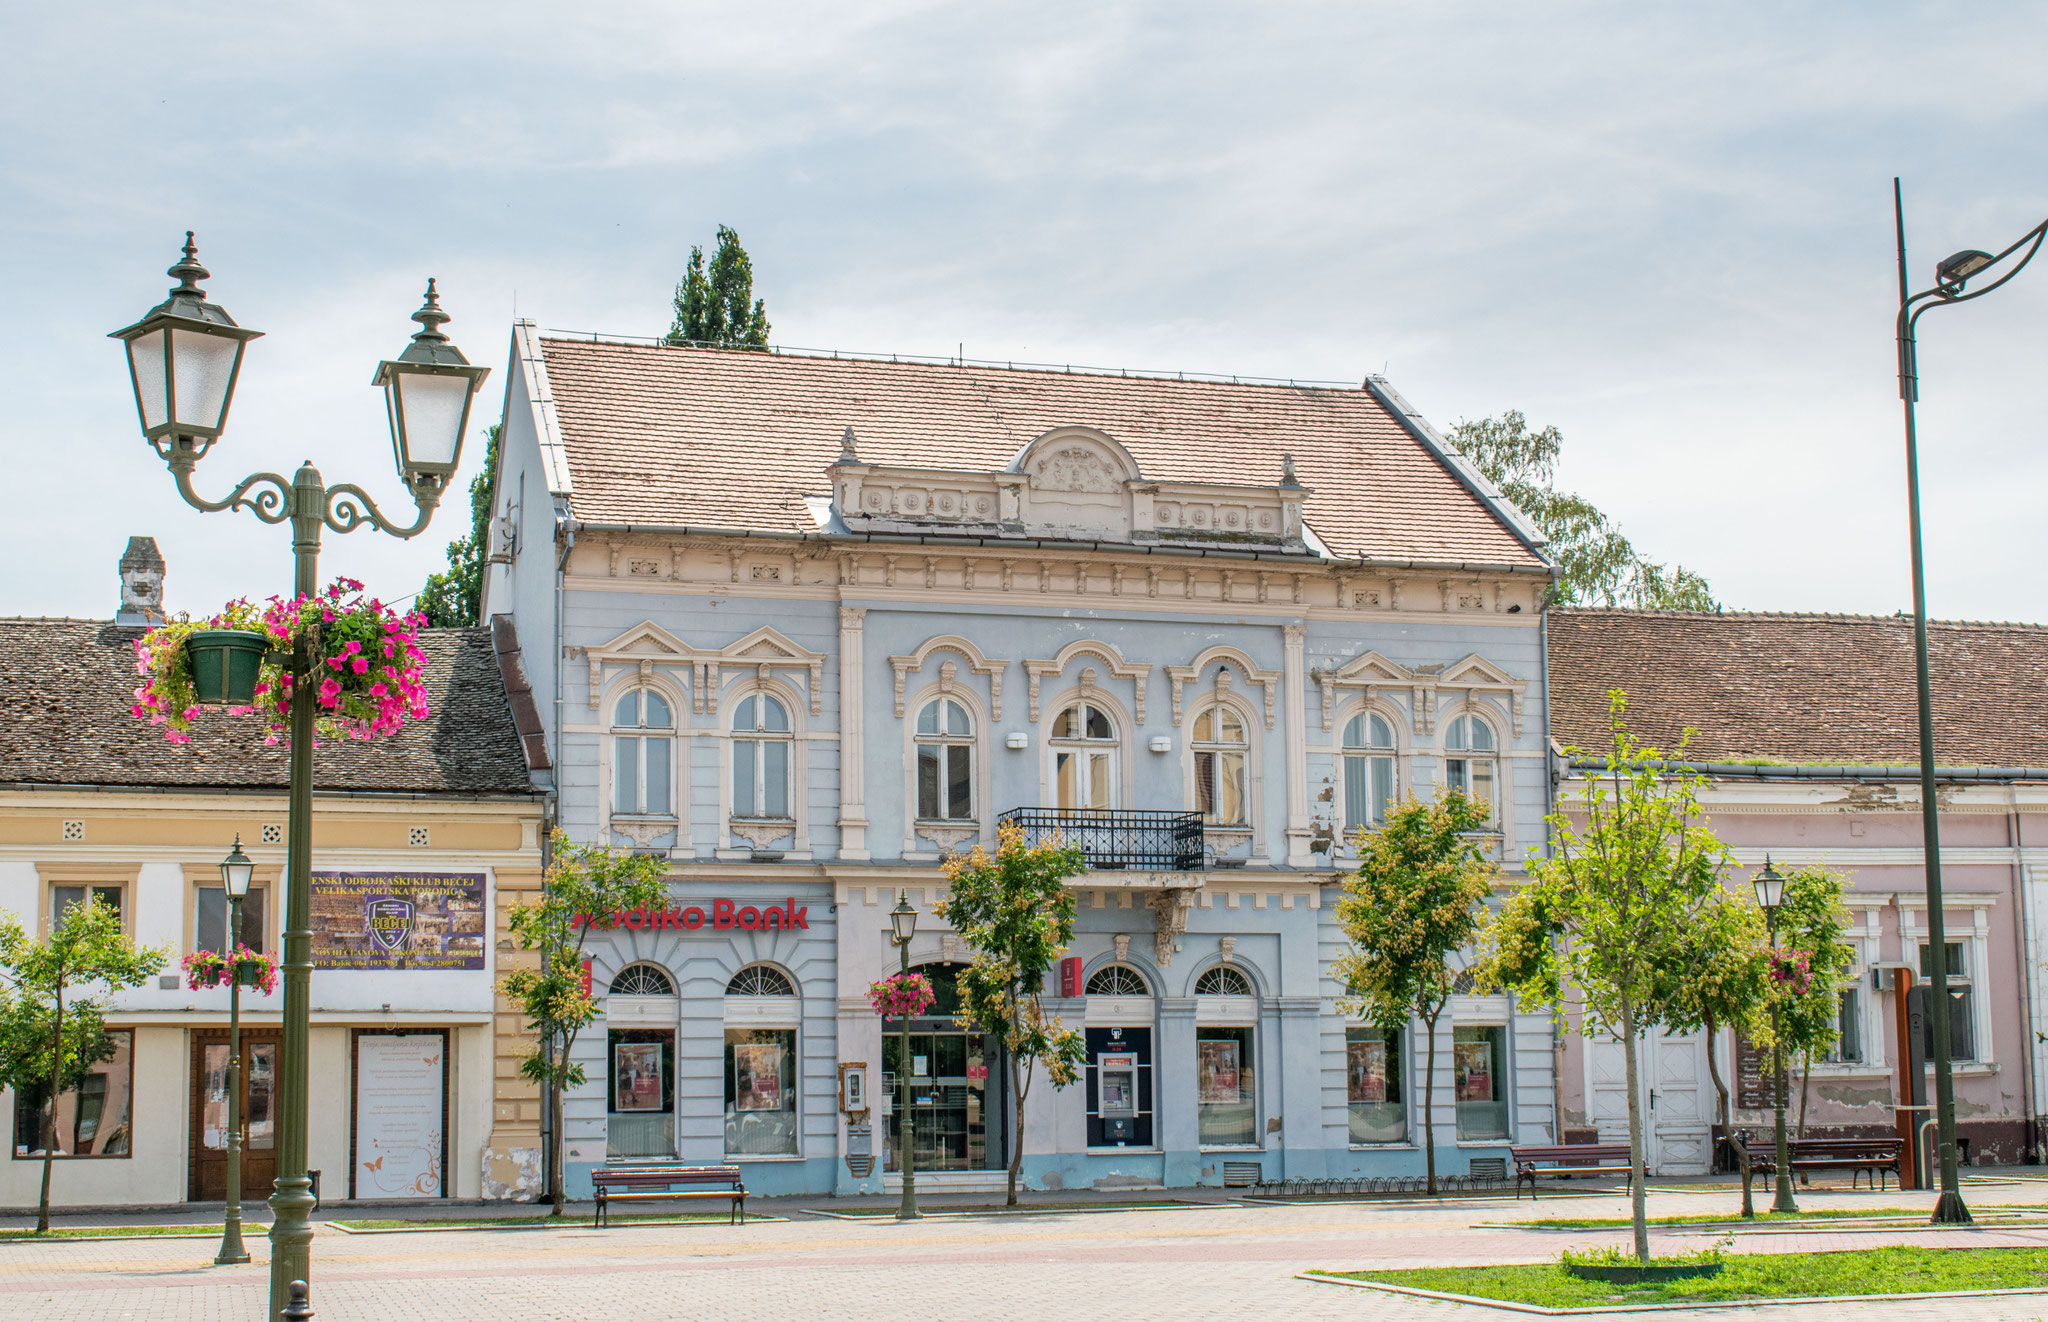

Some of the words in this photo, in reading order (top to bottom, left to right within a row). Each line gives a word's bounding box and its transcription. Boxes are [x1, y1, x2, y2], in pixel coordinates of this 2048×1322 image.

[311, 876, 342, 885] ENSKI
[344, 875, 410, 886] ODBOJKAŠKI
[413, 877, 441, 886] KLUB
[443, 876, 475, 887] BEČEJ
[315, 886, 354, 895] VELIKA
[356, 887, 409, 896] SPORTSKA
[411, 887, 465, 896] PORODICA
[713, 897, 810, 930] Bank
[371, 915, 411, 930] BEČEJ
